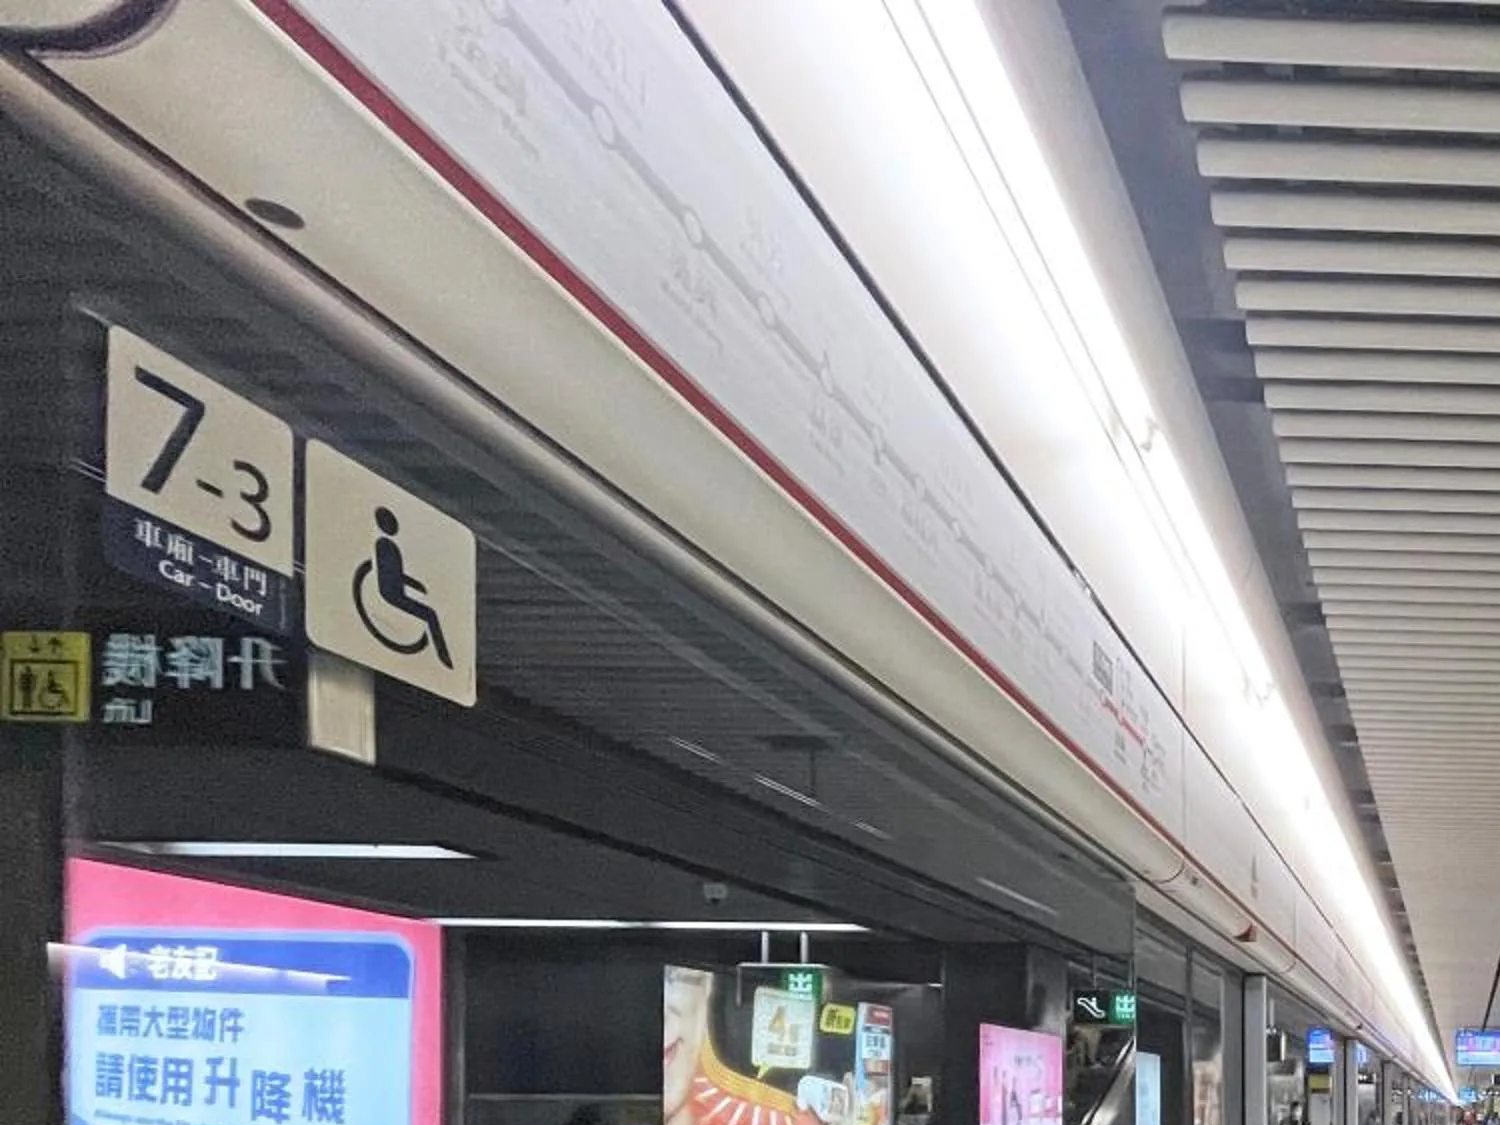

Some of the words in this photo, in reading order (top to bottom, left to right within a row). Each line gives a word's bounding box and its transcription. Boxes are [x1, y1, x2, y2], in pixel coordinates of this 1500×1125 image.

[134, 366, 272, 543] 7-3
[158, 559, 196, 588] Car
[215, 582, 264, 617] Door
